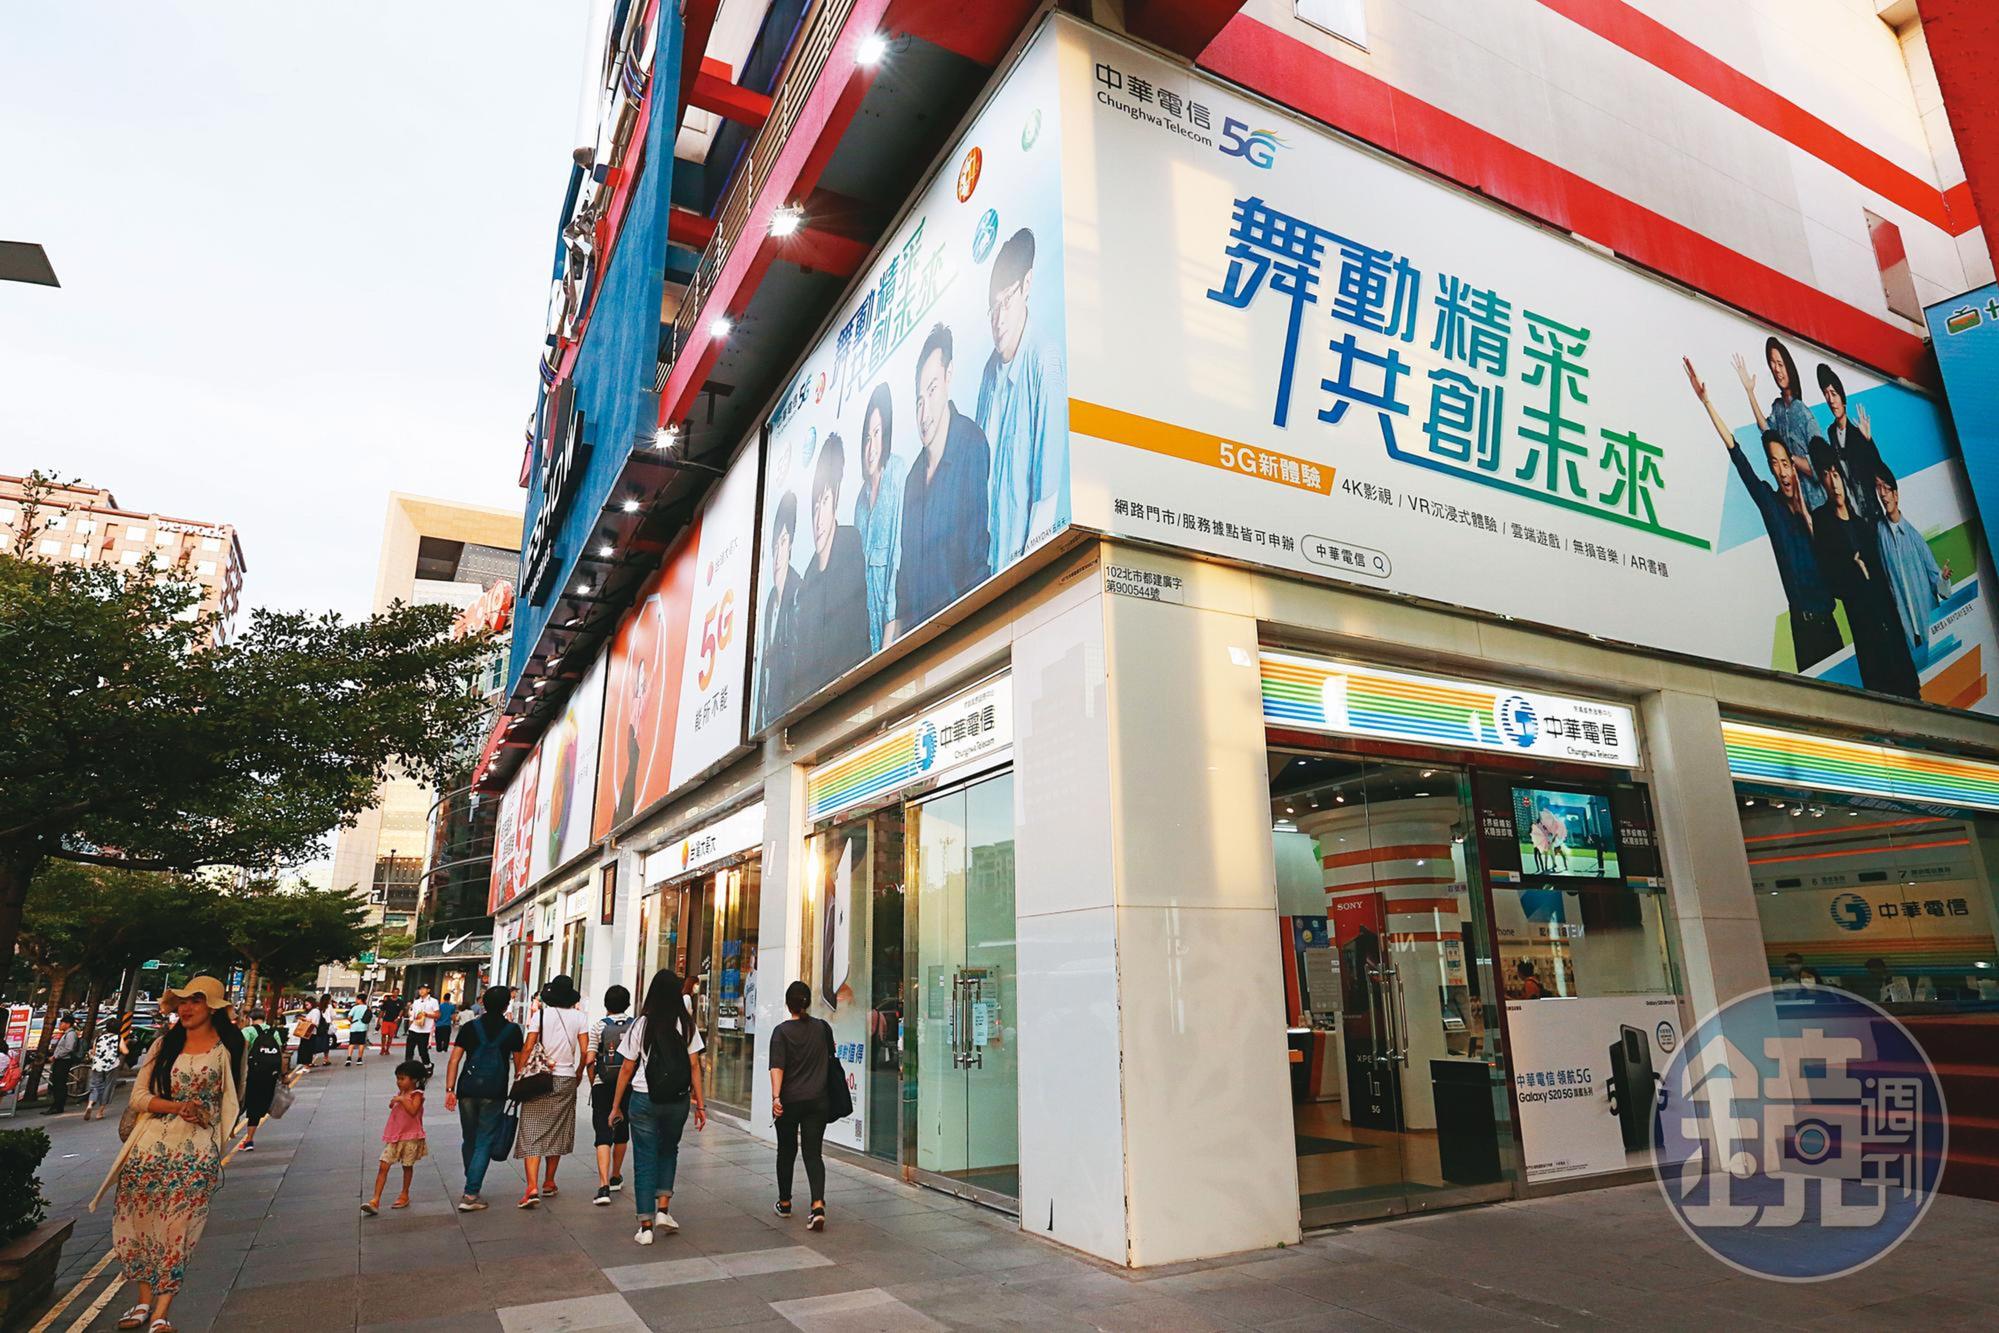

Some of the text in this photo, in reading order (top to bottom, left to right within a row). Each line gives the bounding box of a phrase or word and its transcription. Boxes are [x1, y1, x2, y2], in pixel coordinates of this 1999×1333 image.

[1095, 63, 1211, 130] 中華電信
[1097, 91, 1212, 147] Chunghwa Telecom
[1218, 116, 1276, 170] 5G
[1207, 196, 1591, 428] 舞動精采
[1317, 333, 1668, 528] 共創未來
[1219, 443, 1321, 490] 5G新體驗
[1114, 498, 1295, 552] 網路門市/服務據點皆可申辦
[1341, 478, 1393, 506] 4K影視
[1407, 494, 1497, 533] VR沉浸式體驗
[1511, 522, 1561, 550] 雲端遊戲
[1573, 539, 1619, 565] 無損音樂
[1630, 554, 1670, 578] AR書櫃
[1316, 543, 1366, 568] 中華電信
[1105, 565, 1183, 592] 102北市都建廣字
[1106, 579, 1161, 601] 第900544號
[698, 588, 735, 693] 5G
[940, 704, 995, 748] 中華電信
[1543, 715, 1619, 747] 中華電信
[1337, 901, 1363, 911] SONY
[1878, 898, 1969, 919] 中華電信
[1516, 1068, 1592, 1089] 中華電信 領航5G
[1518, 1088, 1548, 1104] Galaxy
[1549, 1089, 1562, 1099] S20
[1563, 1088, 1574, 1099] 5G
